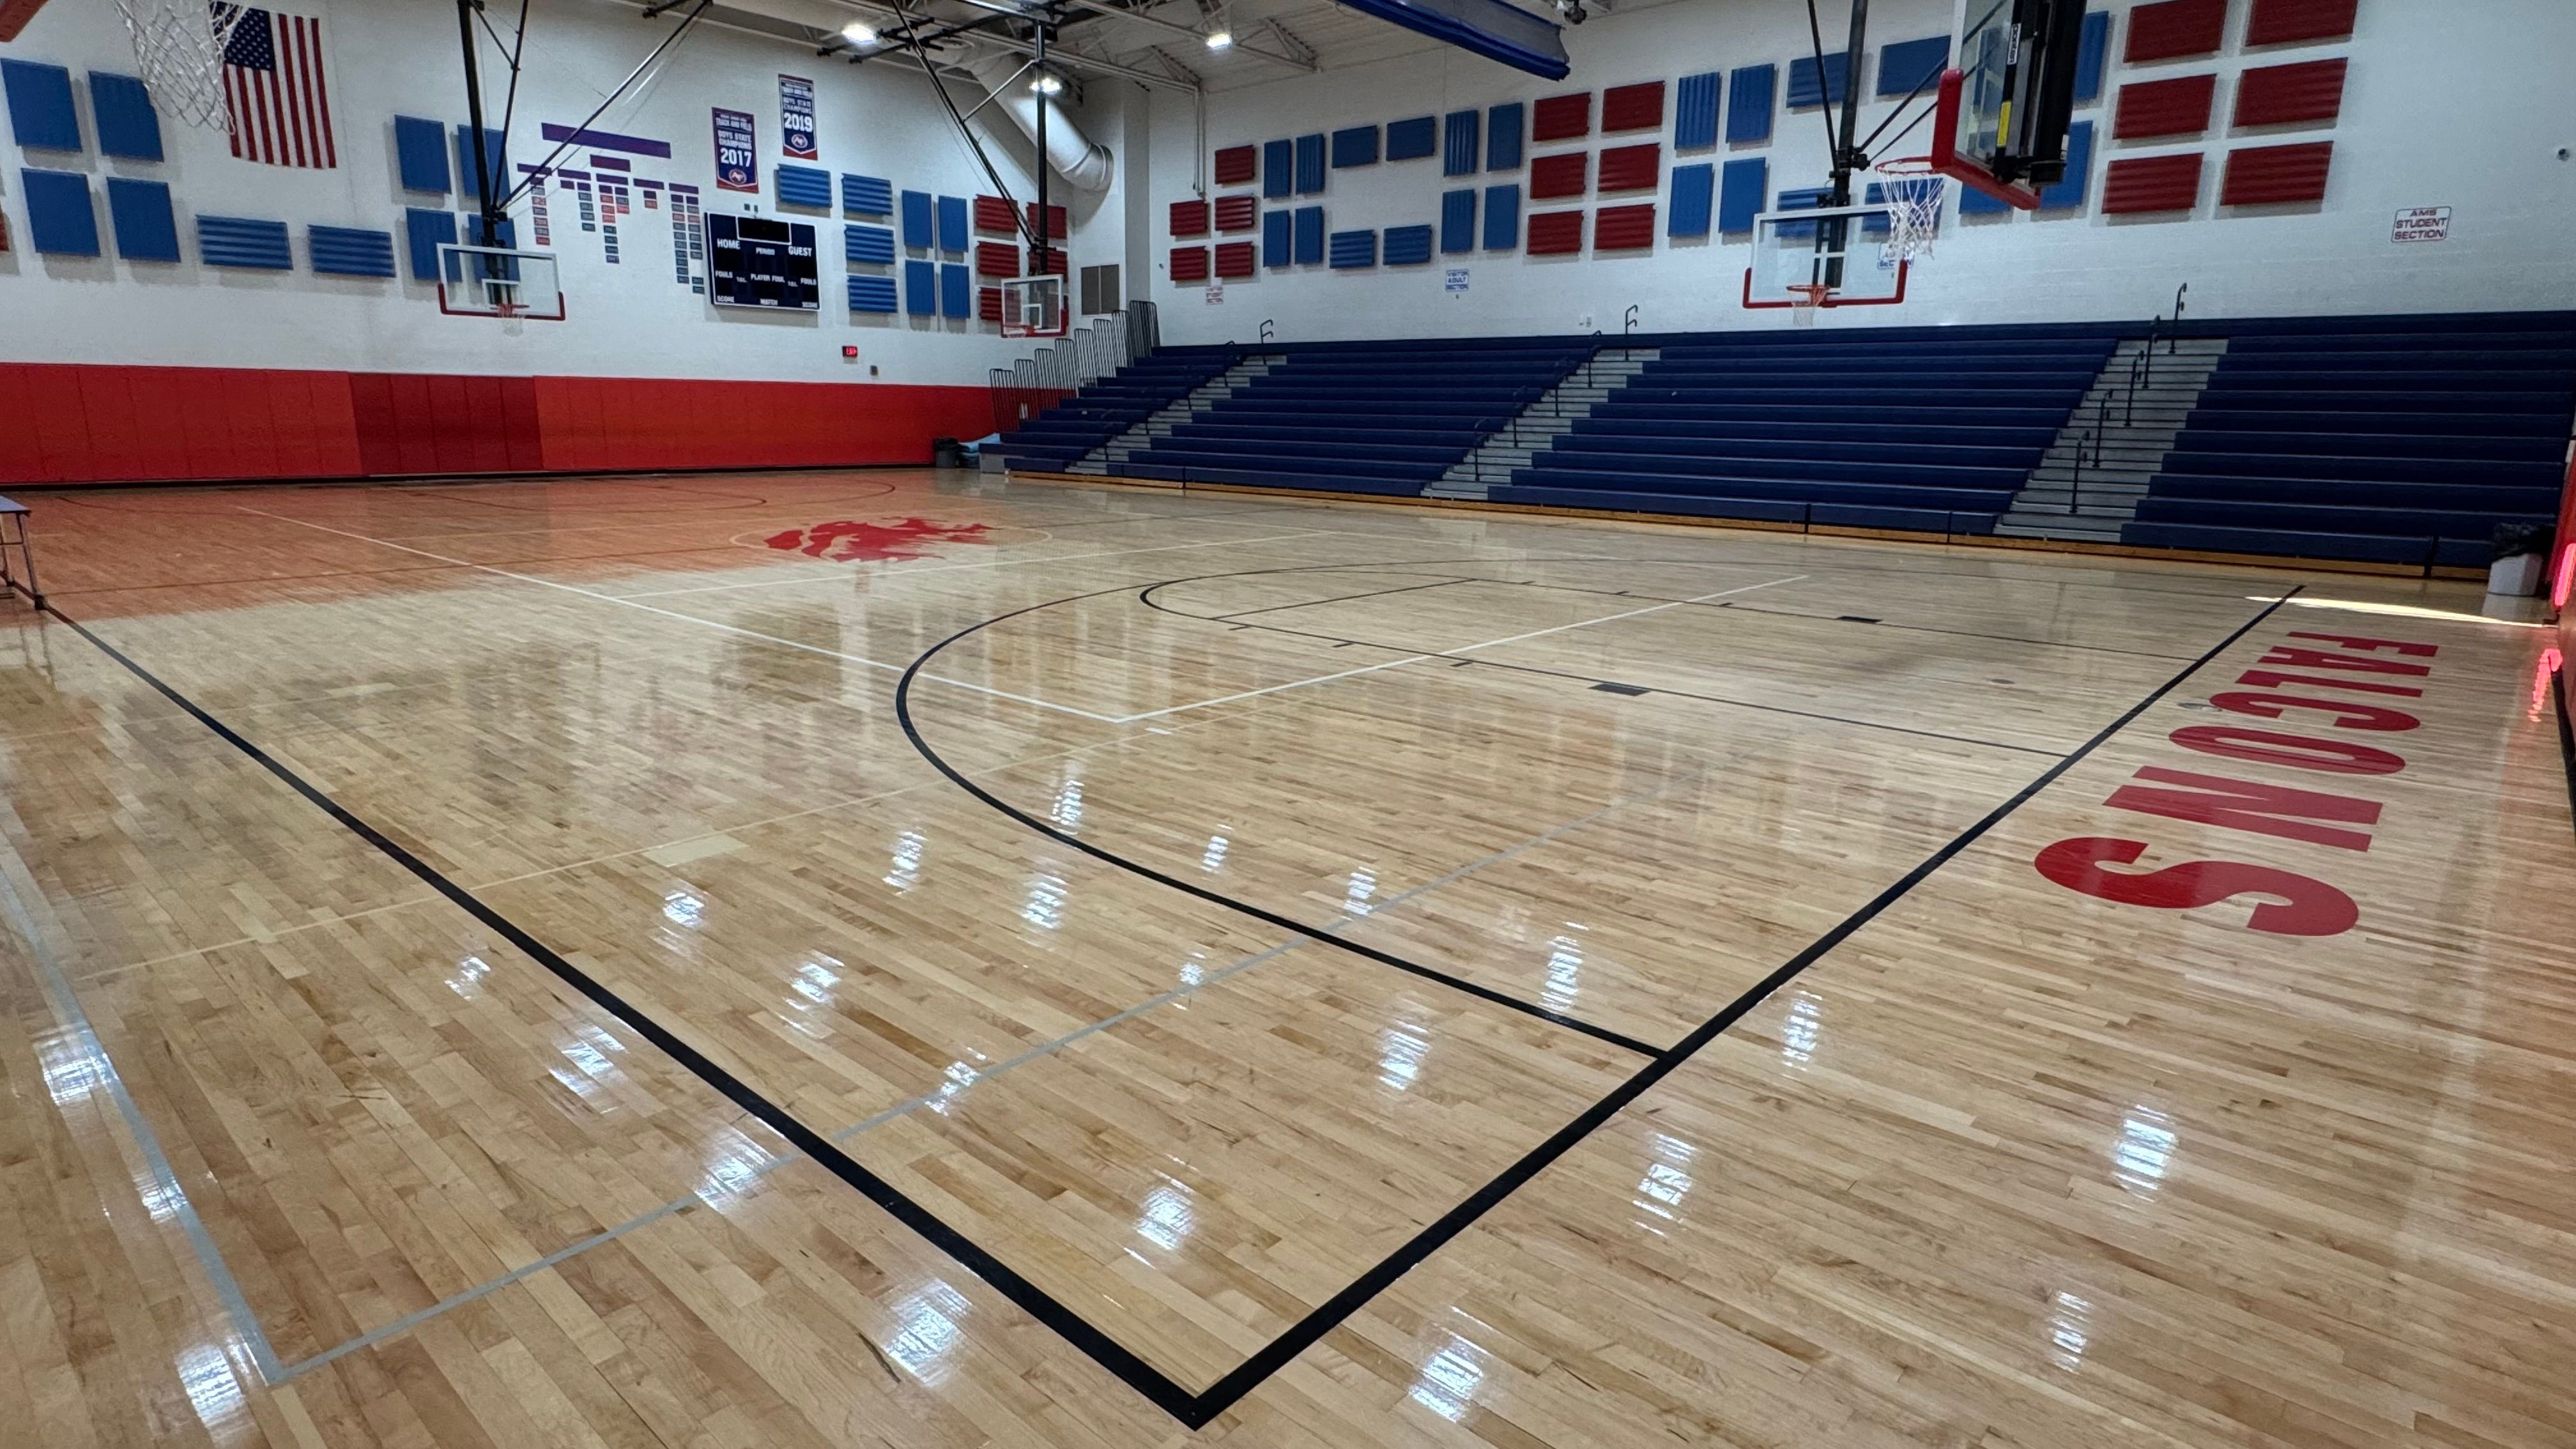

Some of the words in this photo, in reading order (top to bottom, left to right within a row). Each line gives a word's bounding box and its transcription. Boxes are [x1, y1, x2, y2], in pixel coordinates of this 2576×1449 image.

[783, 112, 813, 132] 2019
[720, 148, 752, 167] 2017
[2395, 218, 2448, 228] STUDENT
[2393, 229, 2444, 240] SECTION
[717, 238, 740, 250] HOME
[788, 246, 812, 257] GUEST
[751, 273, 770, 281] PLAYER
[2034, 631, 2439, 937] FALCONS
